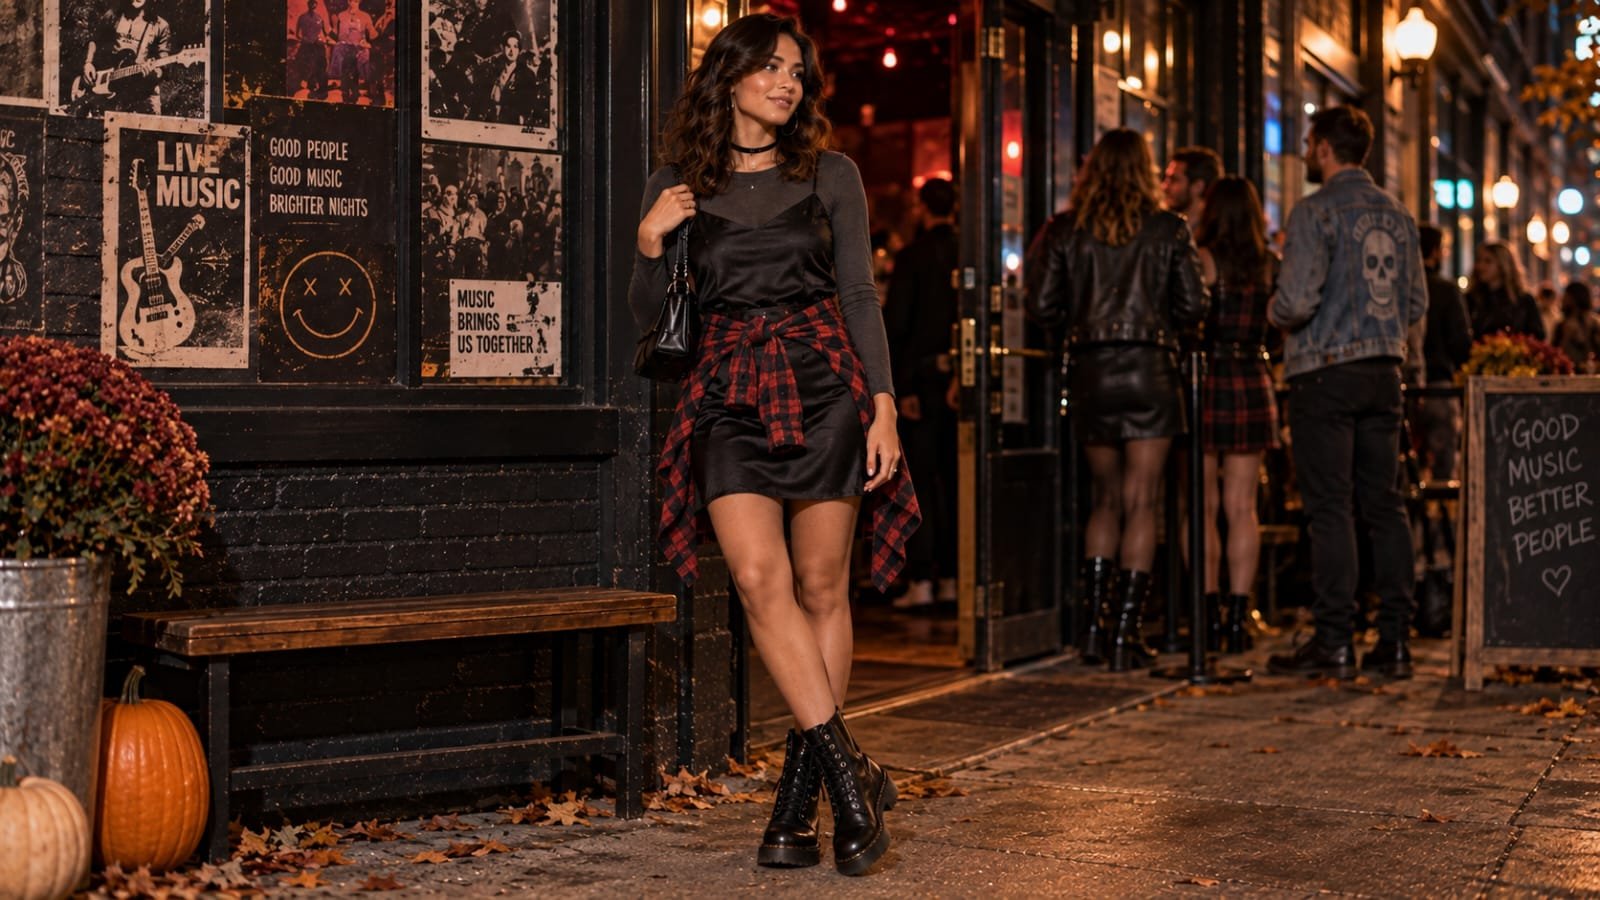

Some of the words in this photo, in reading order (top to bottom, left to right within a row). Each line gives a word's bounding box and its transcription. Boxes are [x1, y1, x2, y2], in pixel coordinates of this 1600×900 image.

[157, 141, 220, 174] LIVE
[270, 137, 301, 158] GOOD
[307, 140, 348, 161] PEOPLE
[270, 166, 301, 186] GOOD
[307, 168, 343, 188] MUSIC
[156, 175, 240, 209] MUSIC
[269, 194, 324, 215] BRIGHTER
[329, 197, 368, 217] NIGHTS
[457, 290, 495, 308] MUSIC
[457, 312, 500, 331] BRINGS
[457, 335, 473, 353] US
[476, 335, 534, 354] TOGETHER
[1512, 413, 1580, 451] GOOD
[1508, 447, 1583, 487] MUSIC
[1507, 481, 1594, 526] BETTER
[1512, 517, 1595, 564] PEOPLE
